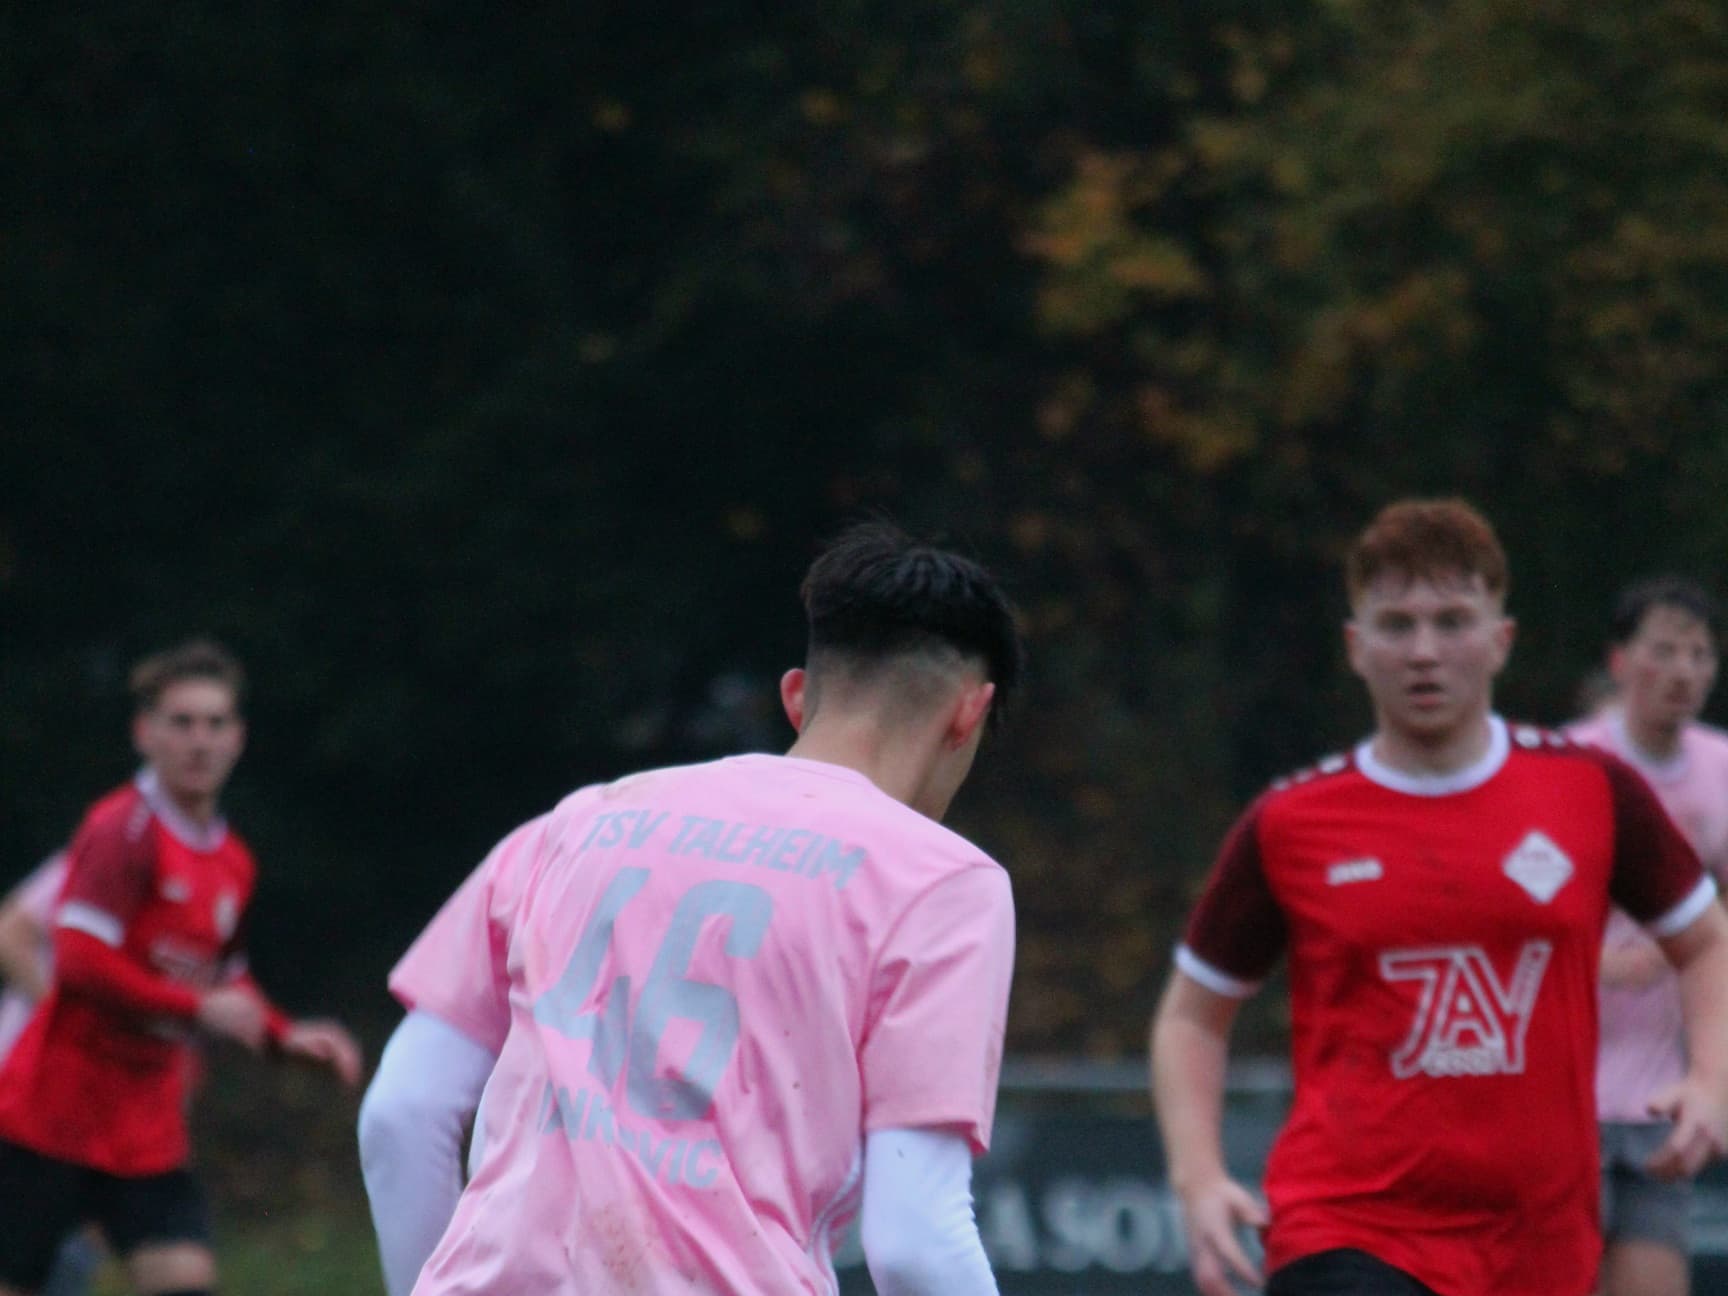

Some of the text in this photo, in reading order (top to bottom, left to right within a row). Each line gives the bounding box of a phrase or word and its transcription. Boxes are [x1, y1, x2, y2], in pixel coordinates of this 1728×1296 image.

[580, 809, 867, 890] TSV TALHEIM
[534, 866, 773, 1121] 46
